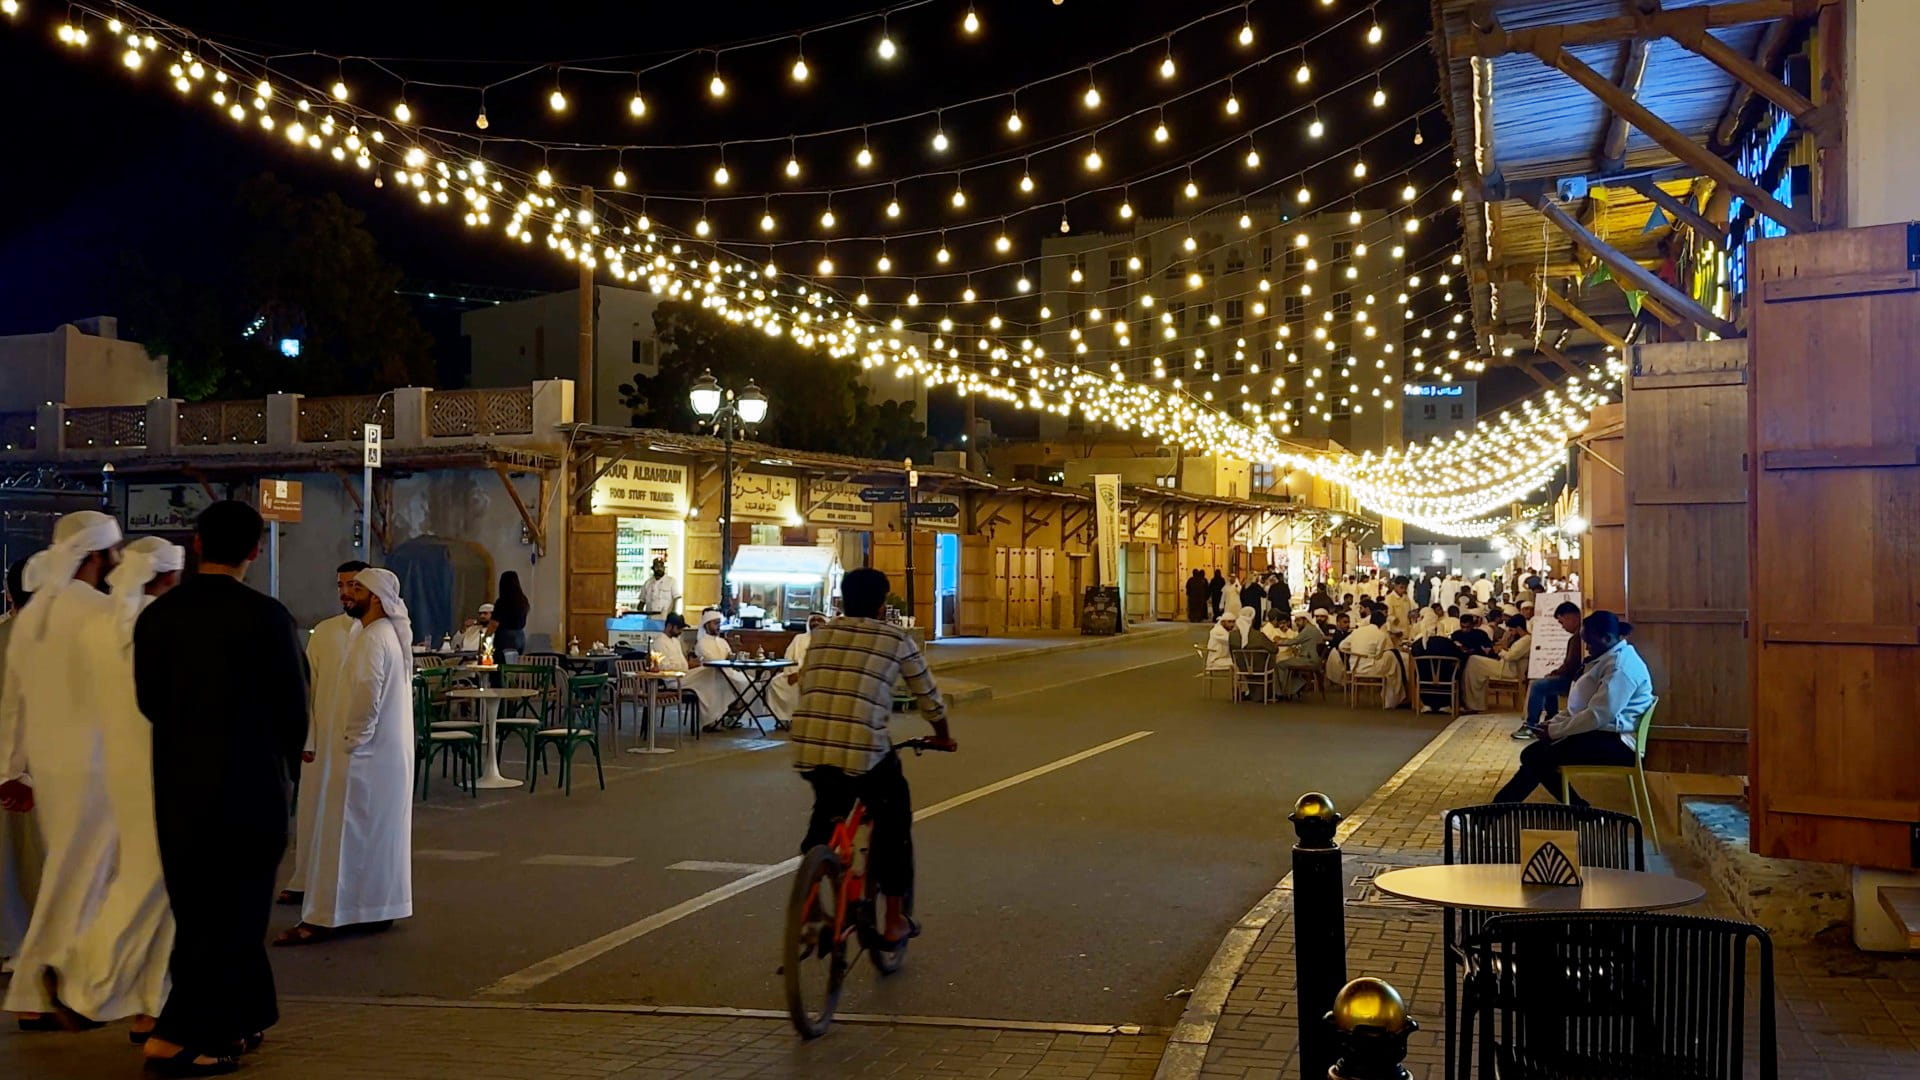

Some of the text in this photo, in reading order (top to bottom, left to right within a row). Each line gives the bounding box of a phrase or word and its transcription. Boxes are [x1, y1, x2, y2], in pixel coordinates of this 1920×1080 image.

[369, 429, 377, 443] P
[610, 488, 625, 499] FOOD
[628, 490, 647, 501] STUFF
